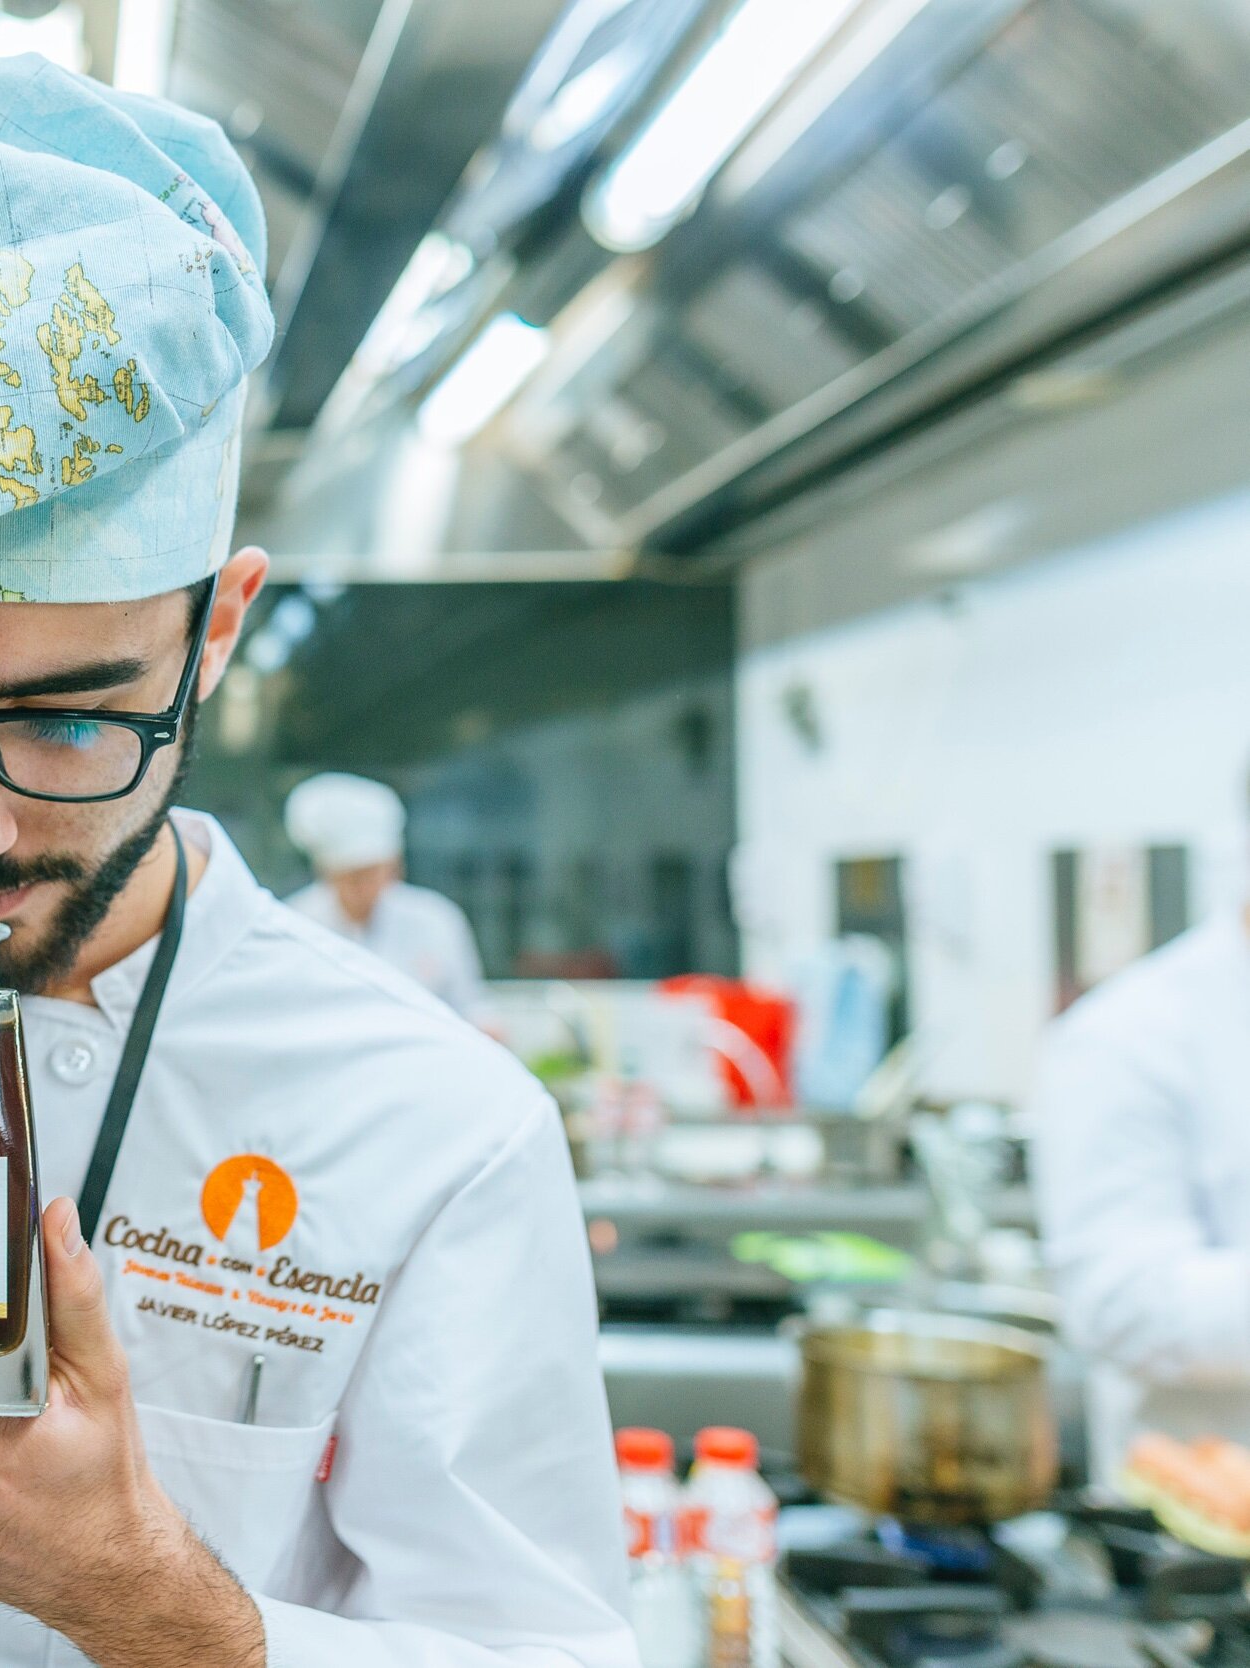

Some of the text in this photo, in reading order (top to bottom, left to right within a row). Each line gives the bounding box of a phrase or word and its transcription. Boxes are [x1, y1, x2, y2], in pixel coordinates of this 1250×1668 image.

[104, 1215, 205, 1268] Cocina
[220, 1257, 253, 1274] con
[268, 1256, 382, 1305] Esencia
[137, 1296, 325, 1353] JAVIER LÓPEZ PÉREZ
